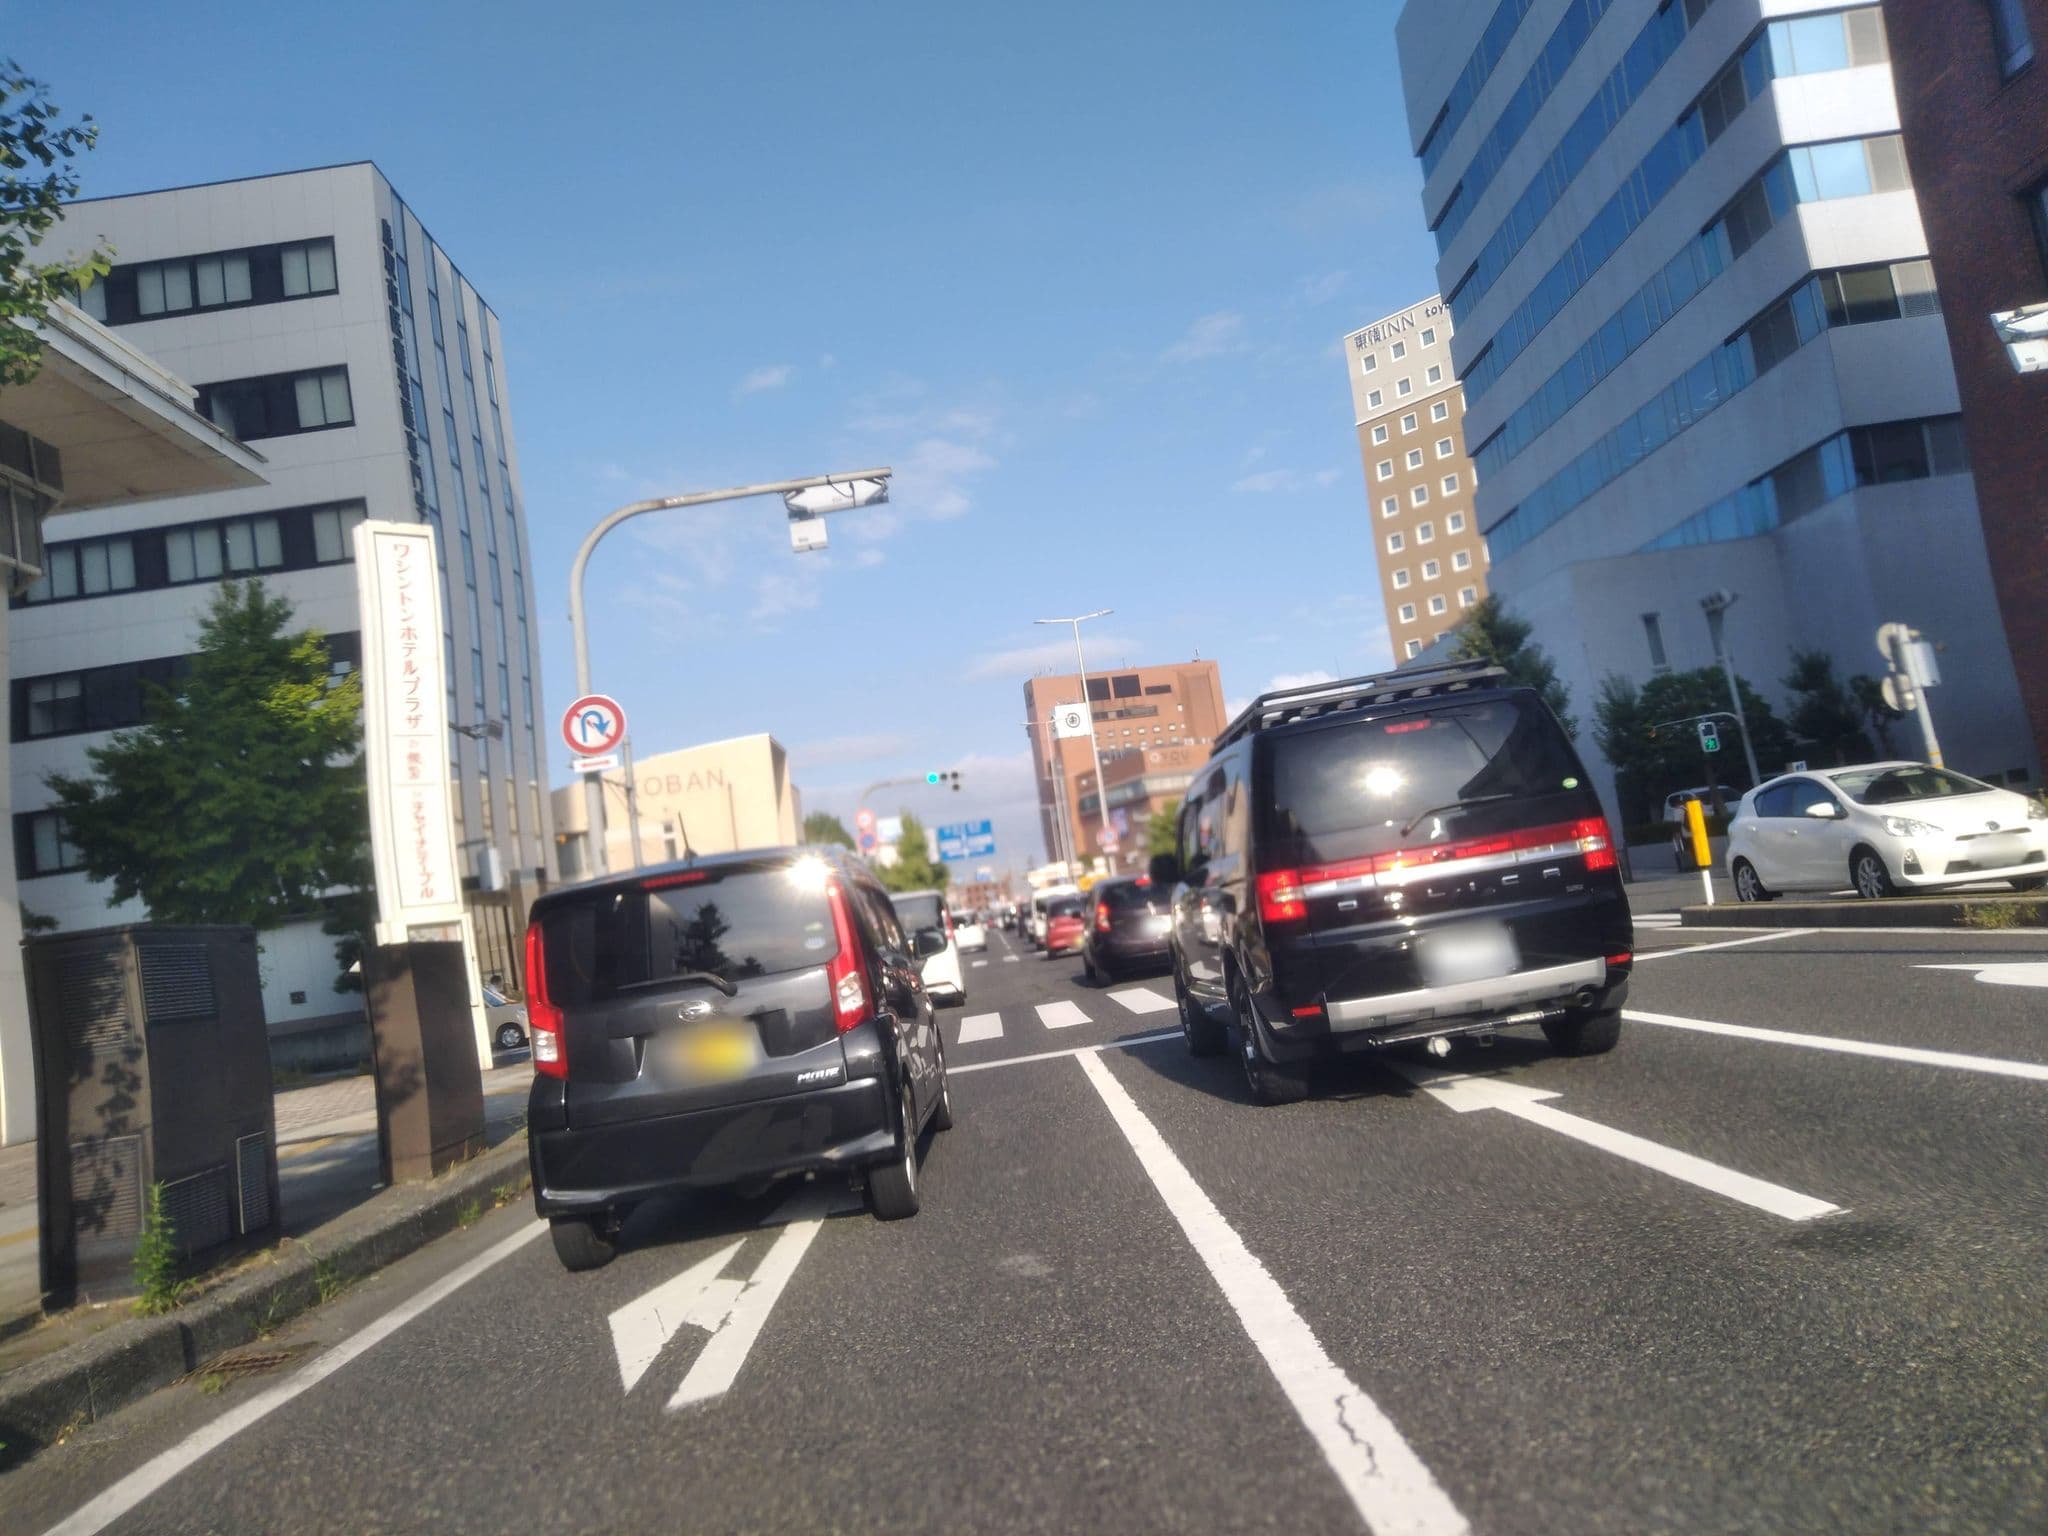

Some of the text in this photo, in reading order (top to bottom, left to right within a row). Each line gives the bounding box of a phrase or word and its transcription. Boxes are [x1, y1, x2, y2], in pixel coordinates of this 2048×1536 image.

[393, 543, 423, 728] ワシントンホテルプラザ
[634, 767, 724, 799] OBAN
